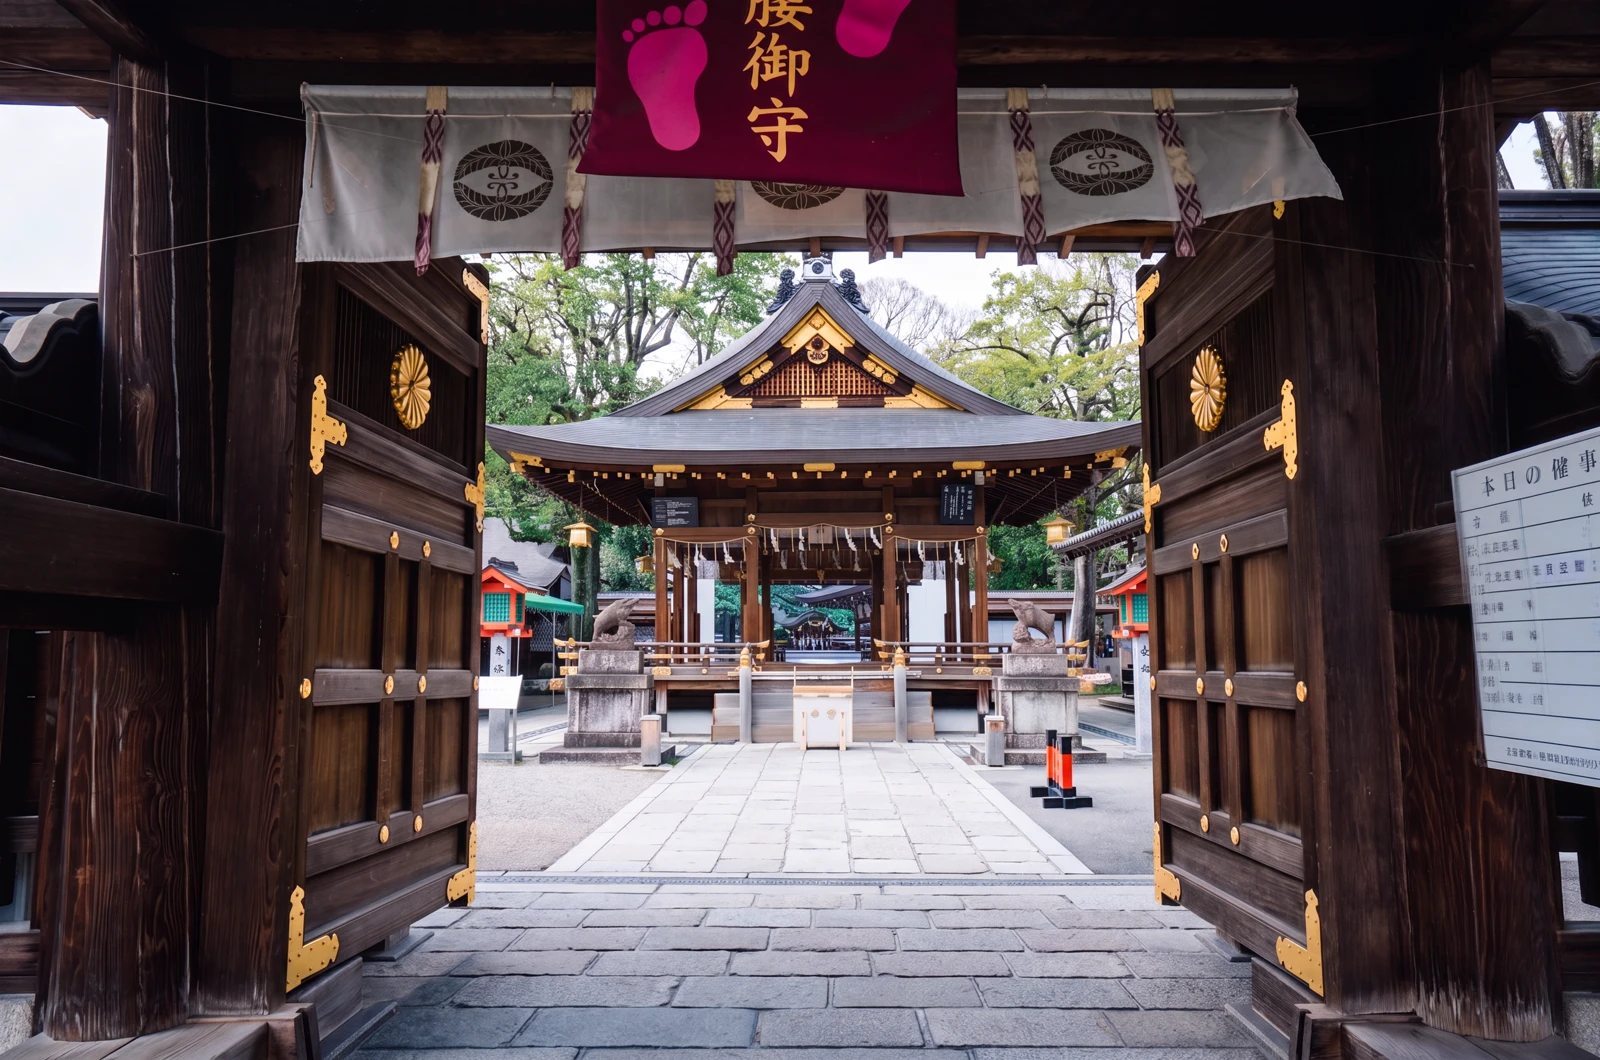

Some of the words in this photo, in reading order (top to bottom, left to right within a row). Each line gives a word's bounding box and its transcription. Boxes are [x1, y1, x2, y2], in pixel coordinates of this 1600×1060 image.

[1481, 449, 1597, 497] 本日の催事
